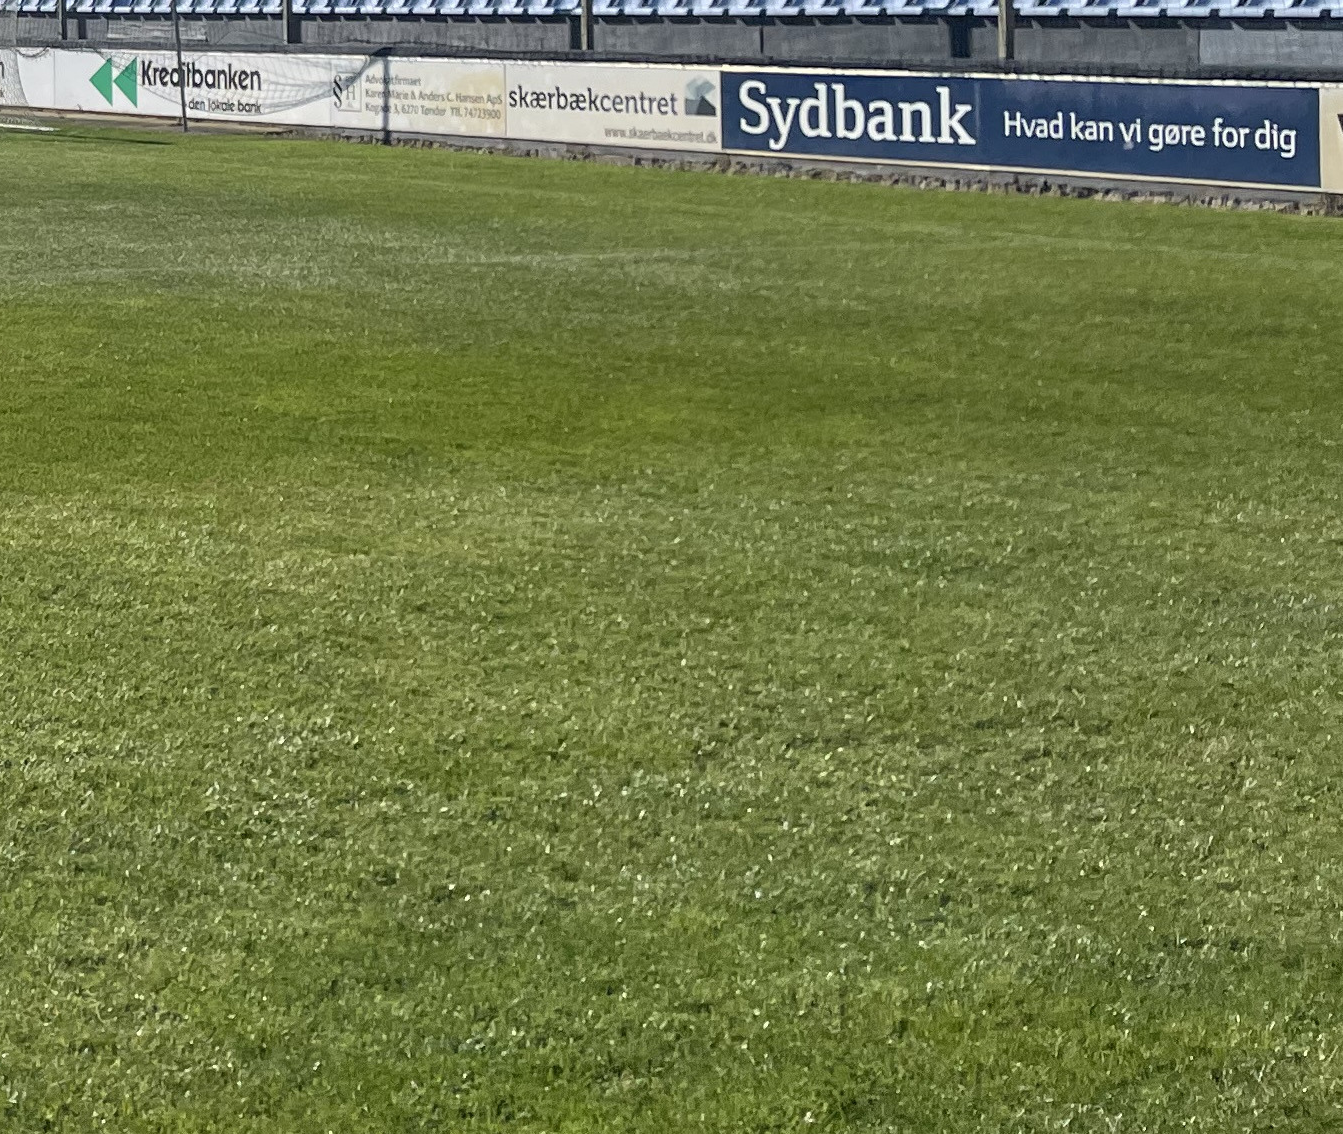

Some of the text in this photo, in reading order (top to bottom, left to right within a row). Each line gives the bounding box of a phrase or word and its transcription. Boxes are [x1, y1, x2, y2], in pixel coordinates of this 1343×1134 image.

[142, 60, 262, 91] Kredtbanken
[365, 75, 422, 87] Advotfirmaet
[237, 101, 262, 114] bank
[454, 94, 485, 105] Hansen
[486, 95, 503, 108] ApS
[508, 84, 679, 117] skærbækcentret
[738, 79, 1297, 158] Sydbank Hvad kan vi gøre for dig
